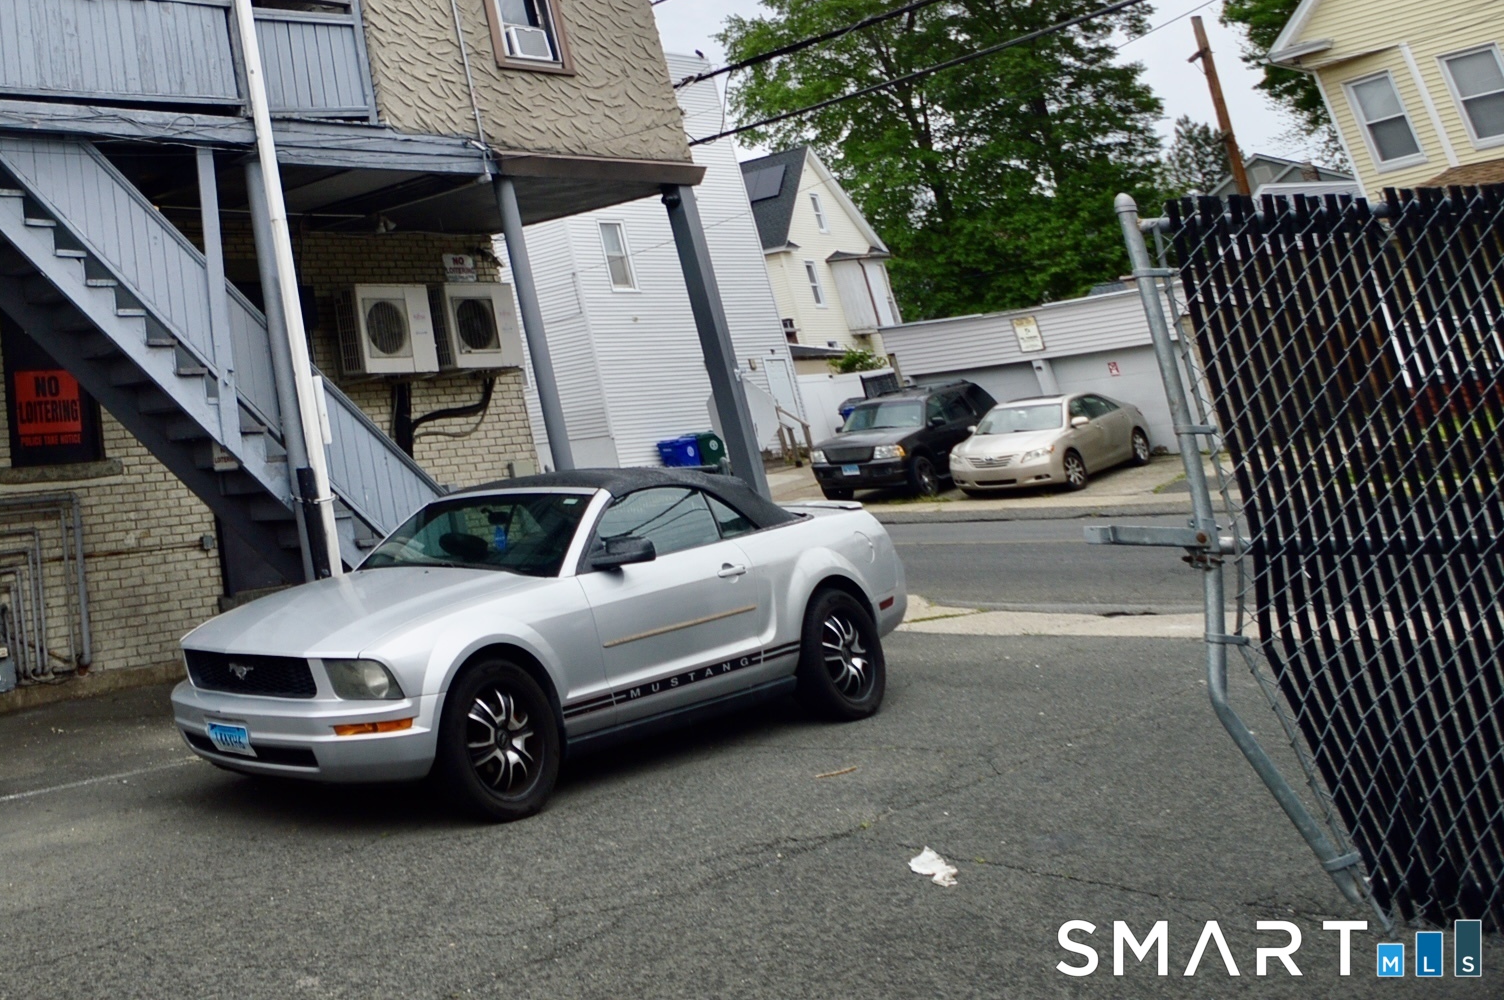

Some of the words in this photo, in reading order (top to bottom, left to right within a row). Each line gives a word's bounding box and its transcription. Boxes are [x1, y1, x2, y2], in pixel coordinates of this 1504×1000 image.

[452, 257, 464, 265] NO
[34, 376, 59, 397] NO
[18, 399, 78, 424] LOITERING
[630, 657, 749, 699] MUSTANG
